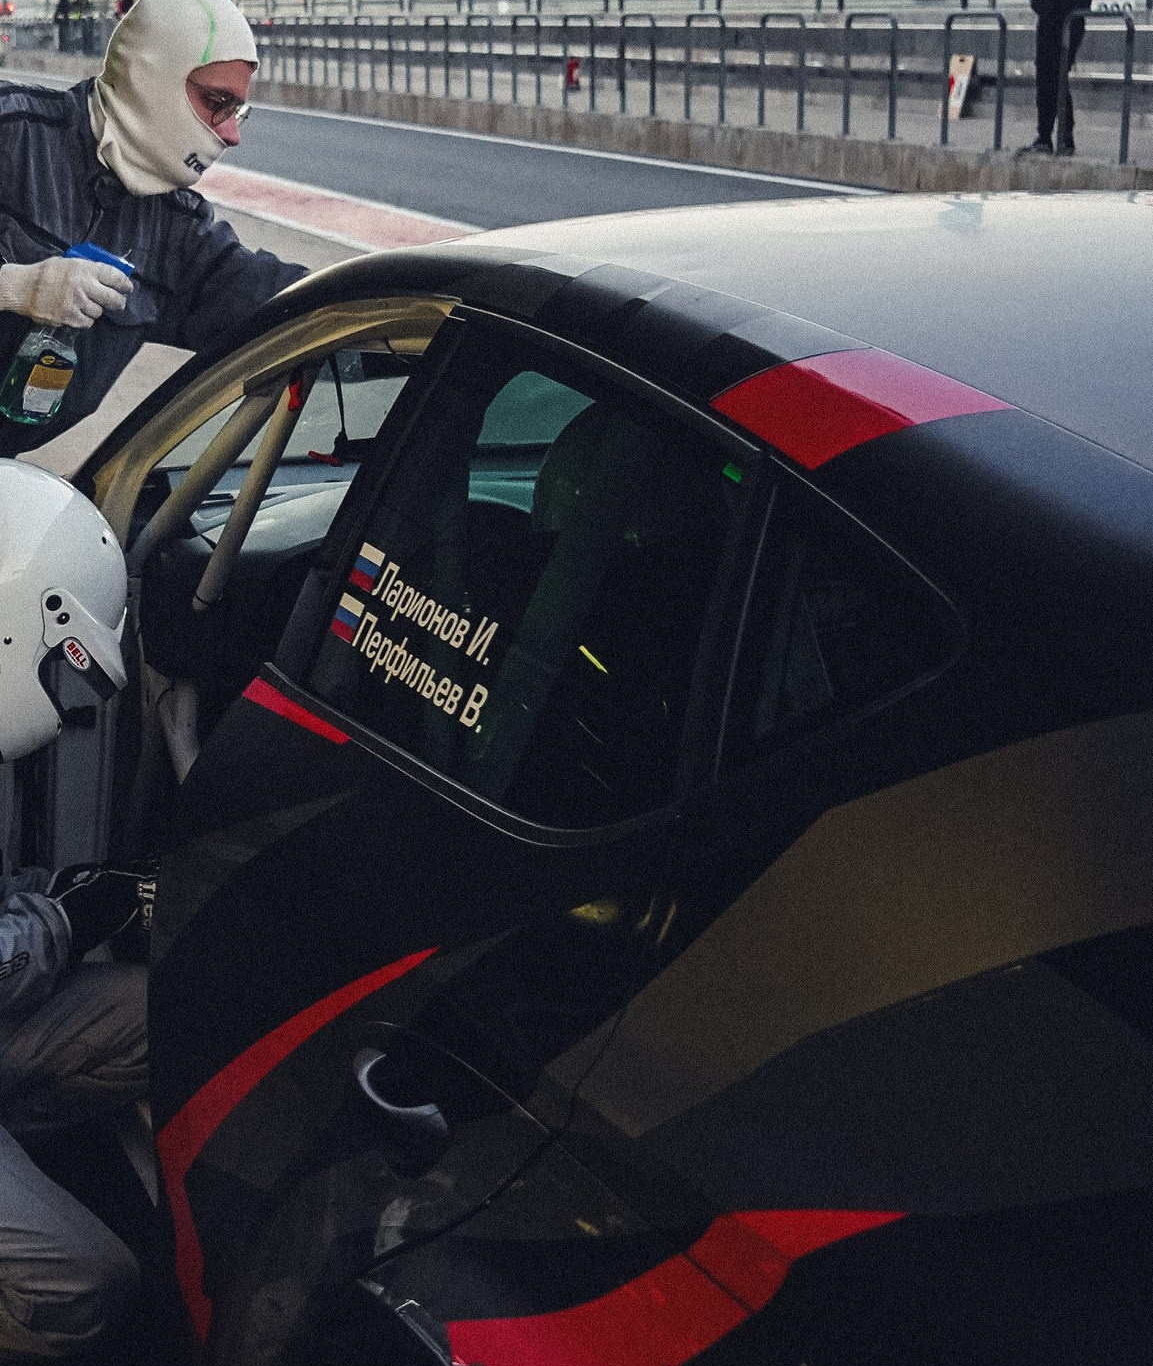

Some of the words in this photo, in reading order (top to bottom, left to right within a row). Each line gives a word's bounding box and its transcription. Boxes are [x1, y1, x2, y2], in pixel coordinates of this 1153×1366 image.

[67, 641, 87, 668] BELL
[371, 561, 470, 649] Ларионов
[465, 616, 499, 666] И.
[352, 611, 464, 715] Перфильев
[459, 683, 489, 733] В.
